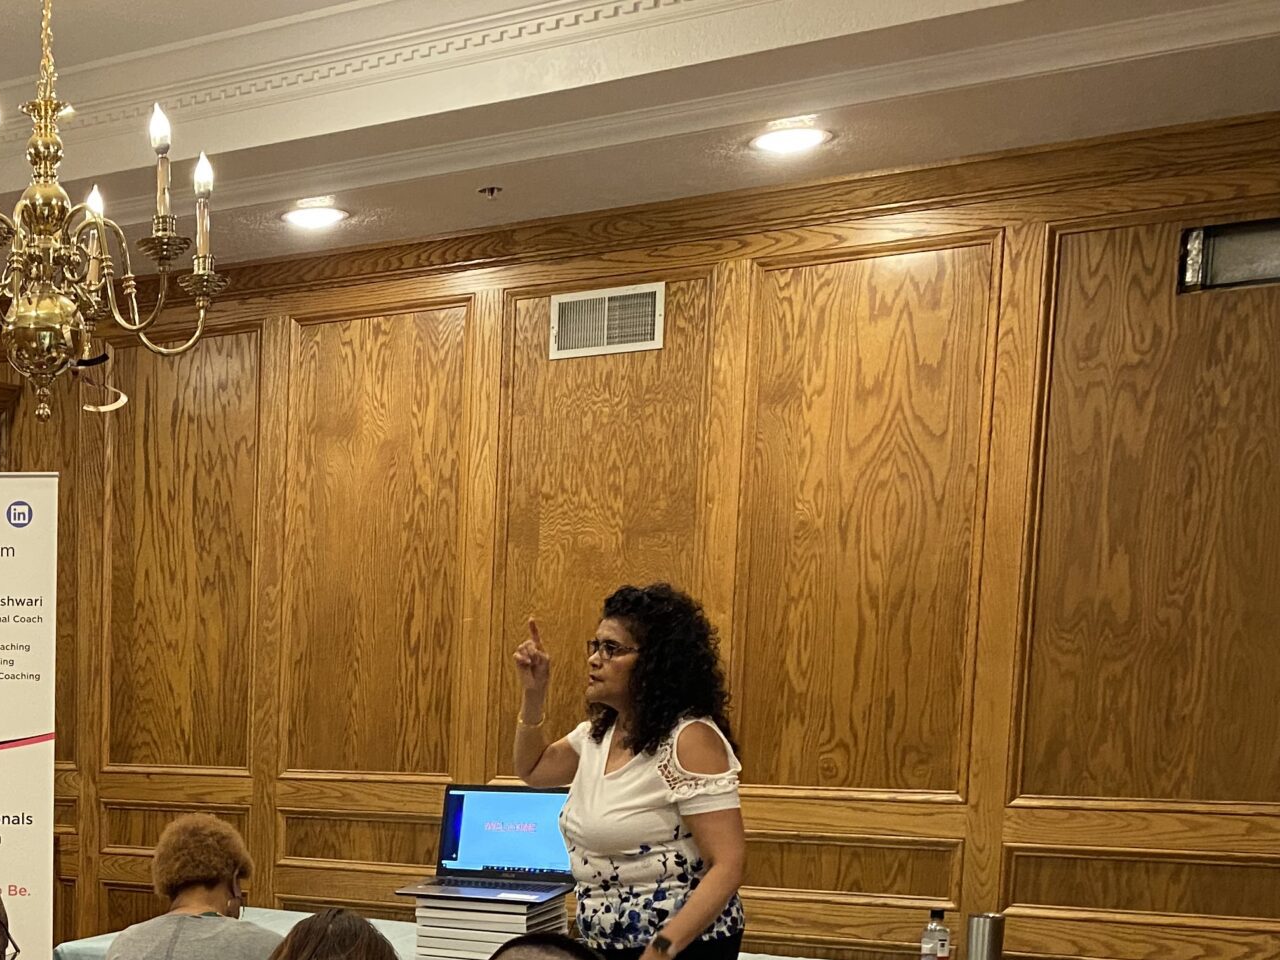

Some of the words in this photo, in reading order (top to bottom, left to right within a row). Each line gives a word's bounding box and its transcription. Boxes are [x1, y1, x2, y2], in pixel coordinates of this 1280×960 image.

[13, 508, 26, 521] in
[12, 615, 43, 623] Coach
[7, 884, 31, 897] Be.
